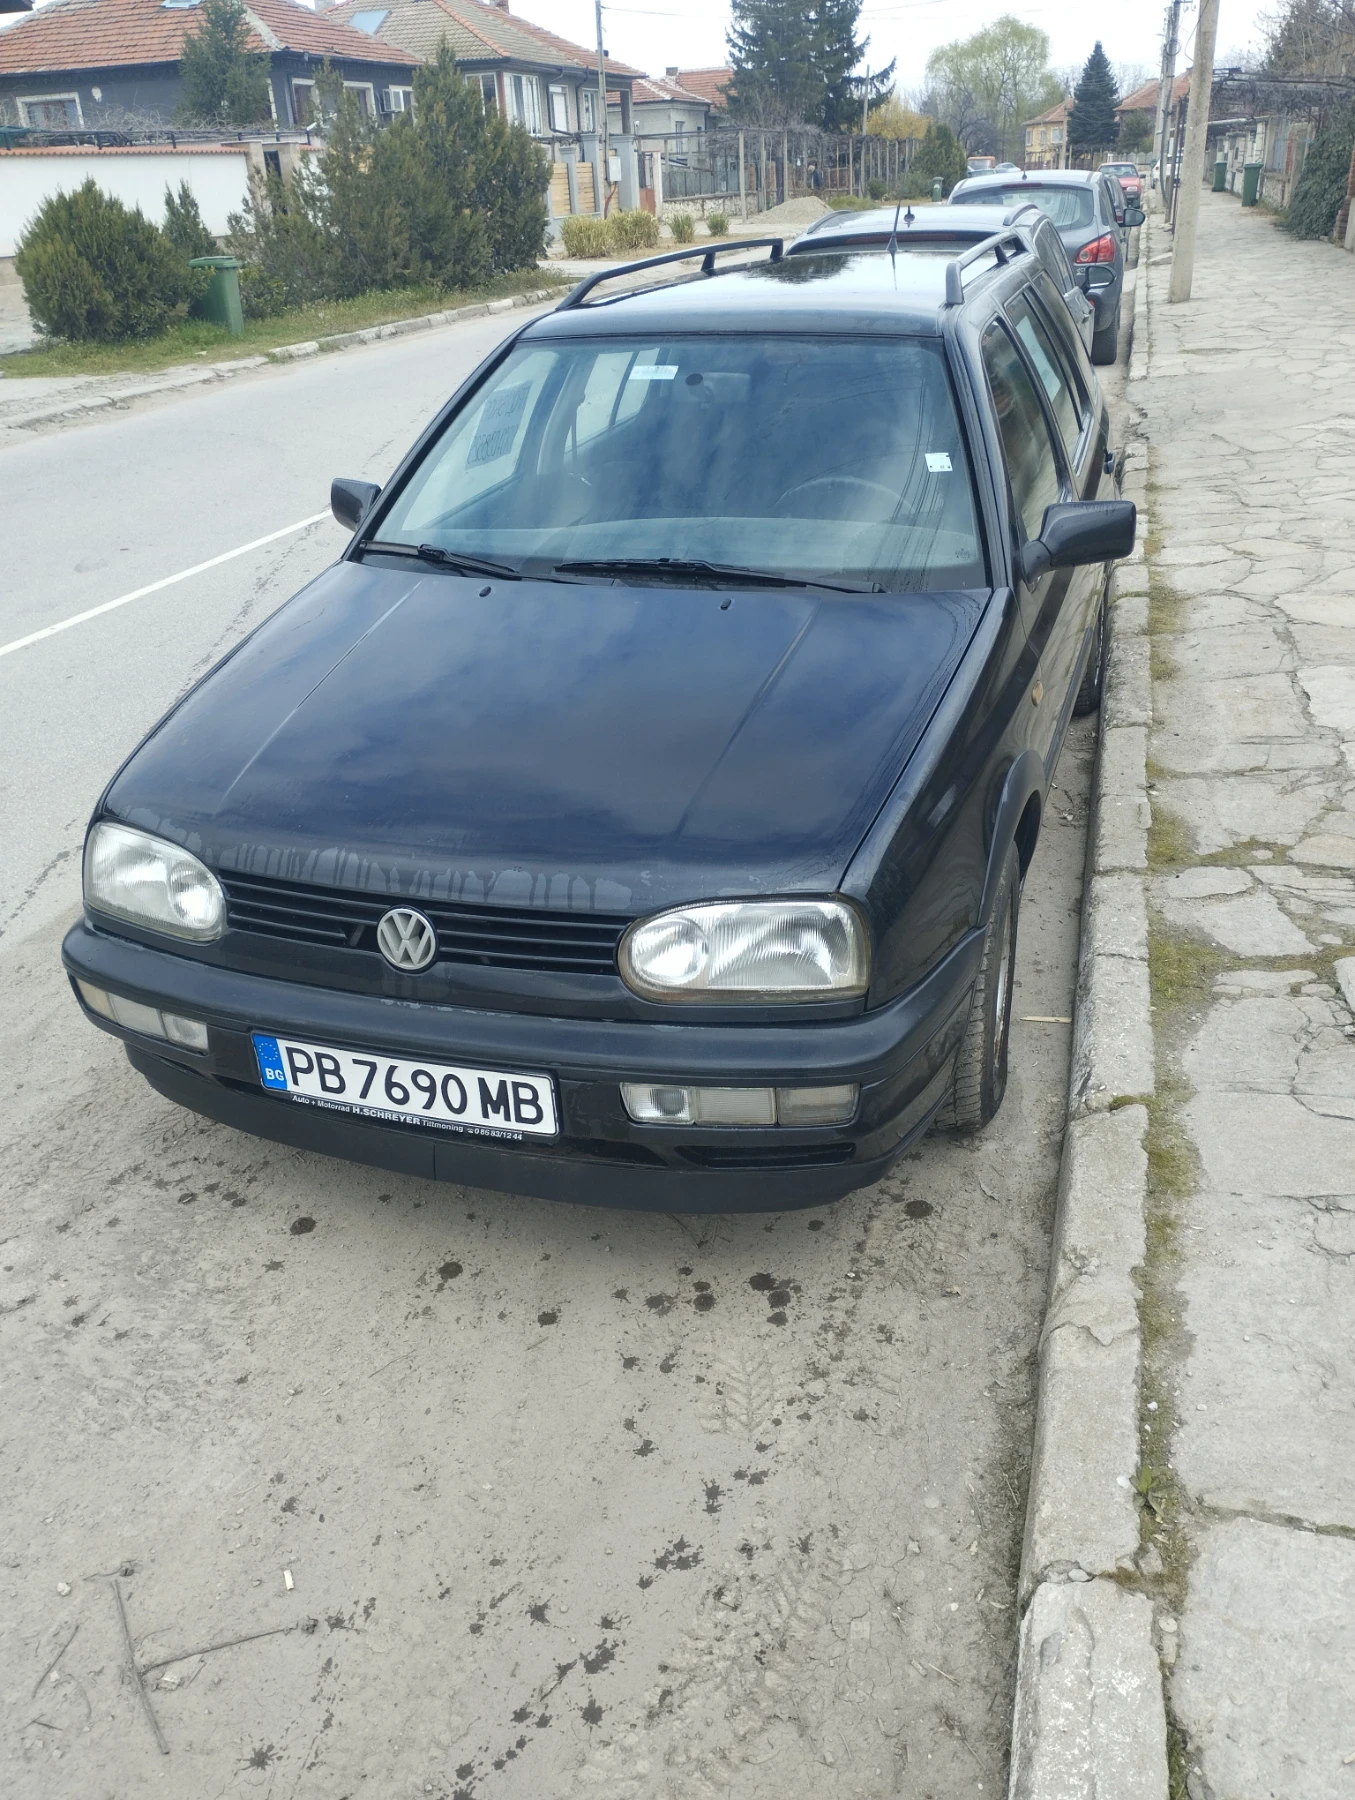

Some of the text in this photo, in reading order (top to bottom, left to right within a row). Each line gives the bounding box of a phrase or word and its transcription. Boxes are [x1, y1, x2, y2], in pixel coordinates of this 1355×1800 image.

[377, 908, 436, 970] VW
[265, 1067, 285, 1082] BG
[285, 1046, 544, 1126] PB 7690 MB
[292, 1095, 310, 1105] Auto
[317, 1100, 351, 1113] Motorrad
[352, 1106, 421, 1125] H.SCHREYER
